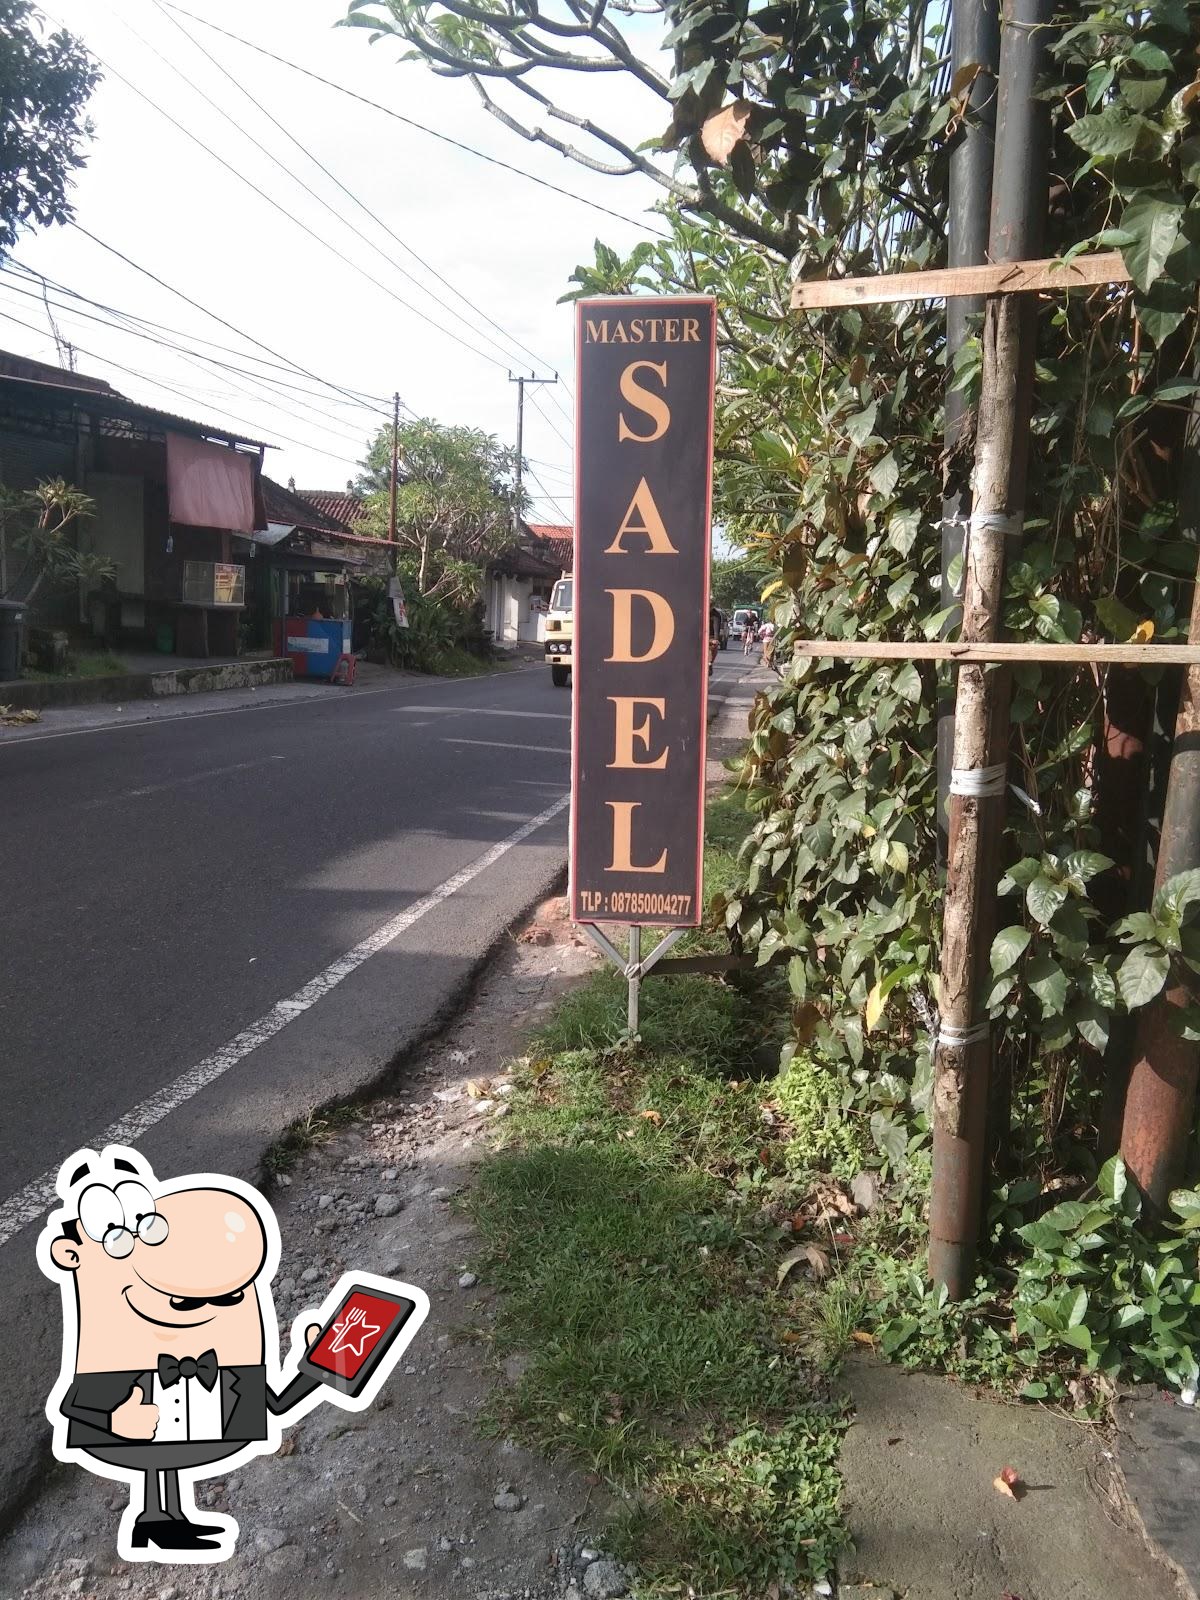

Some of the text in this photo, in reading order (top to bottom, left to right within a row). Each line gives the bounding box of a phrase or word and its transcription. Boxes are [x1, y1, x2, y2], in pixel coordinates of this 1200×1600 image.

[586, 319, 701, 343] MASTER
[604, 361, 679, 873] SADEL
[611, 892, 691, 915] 087850004277
